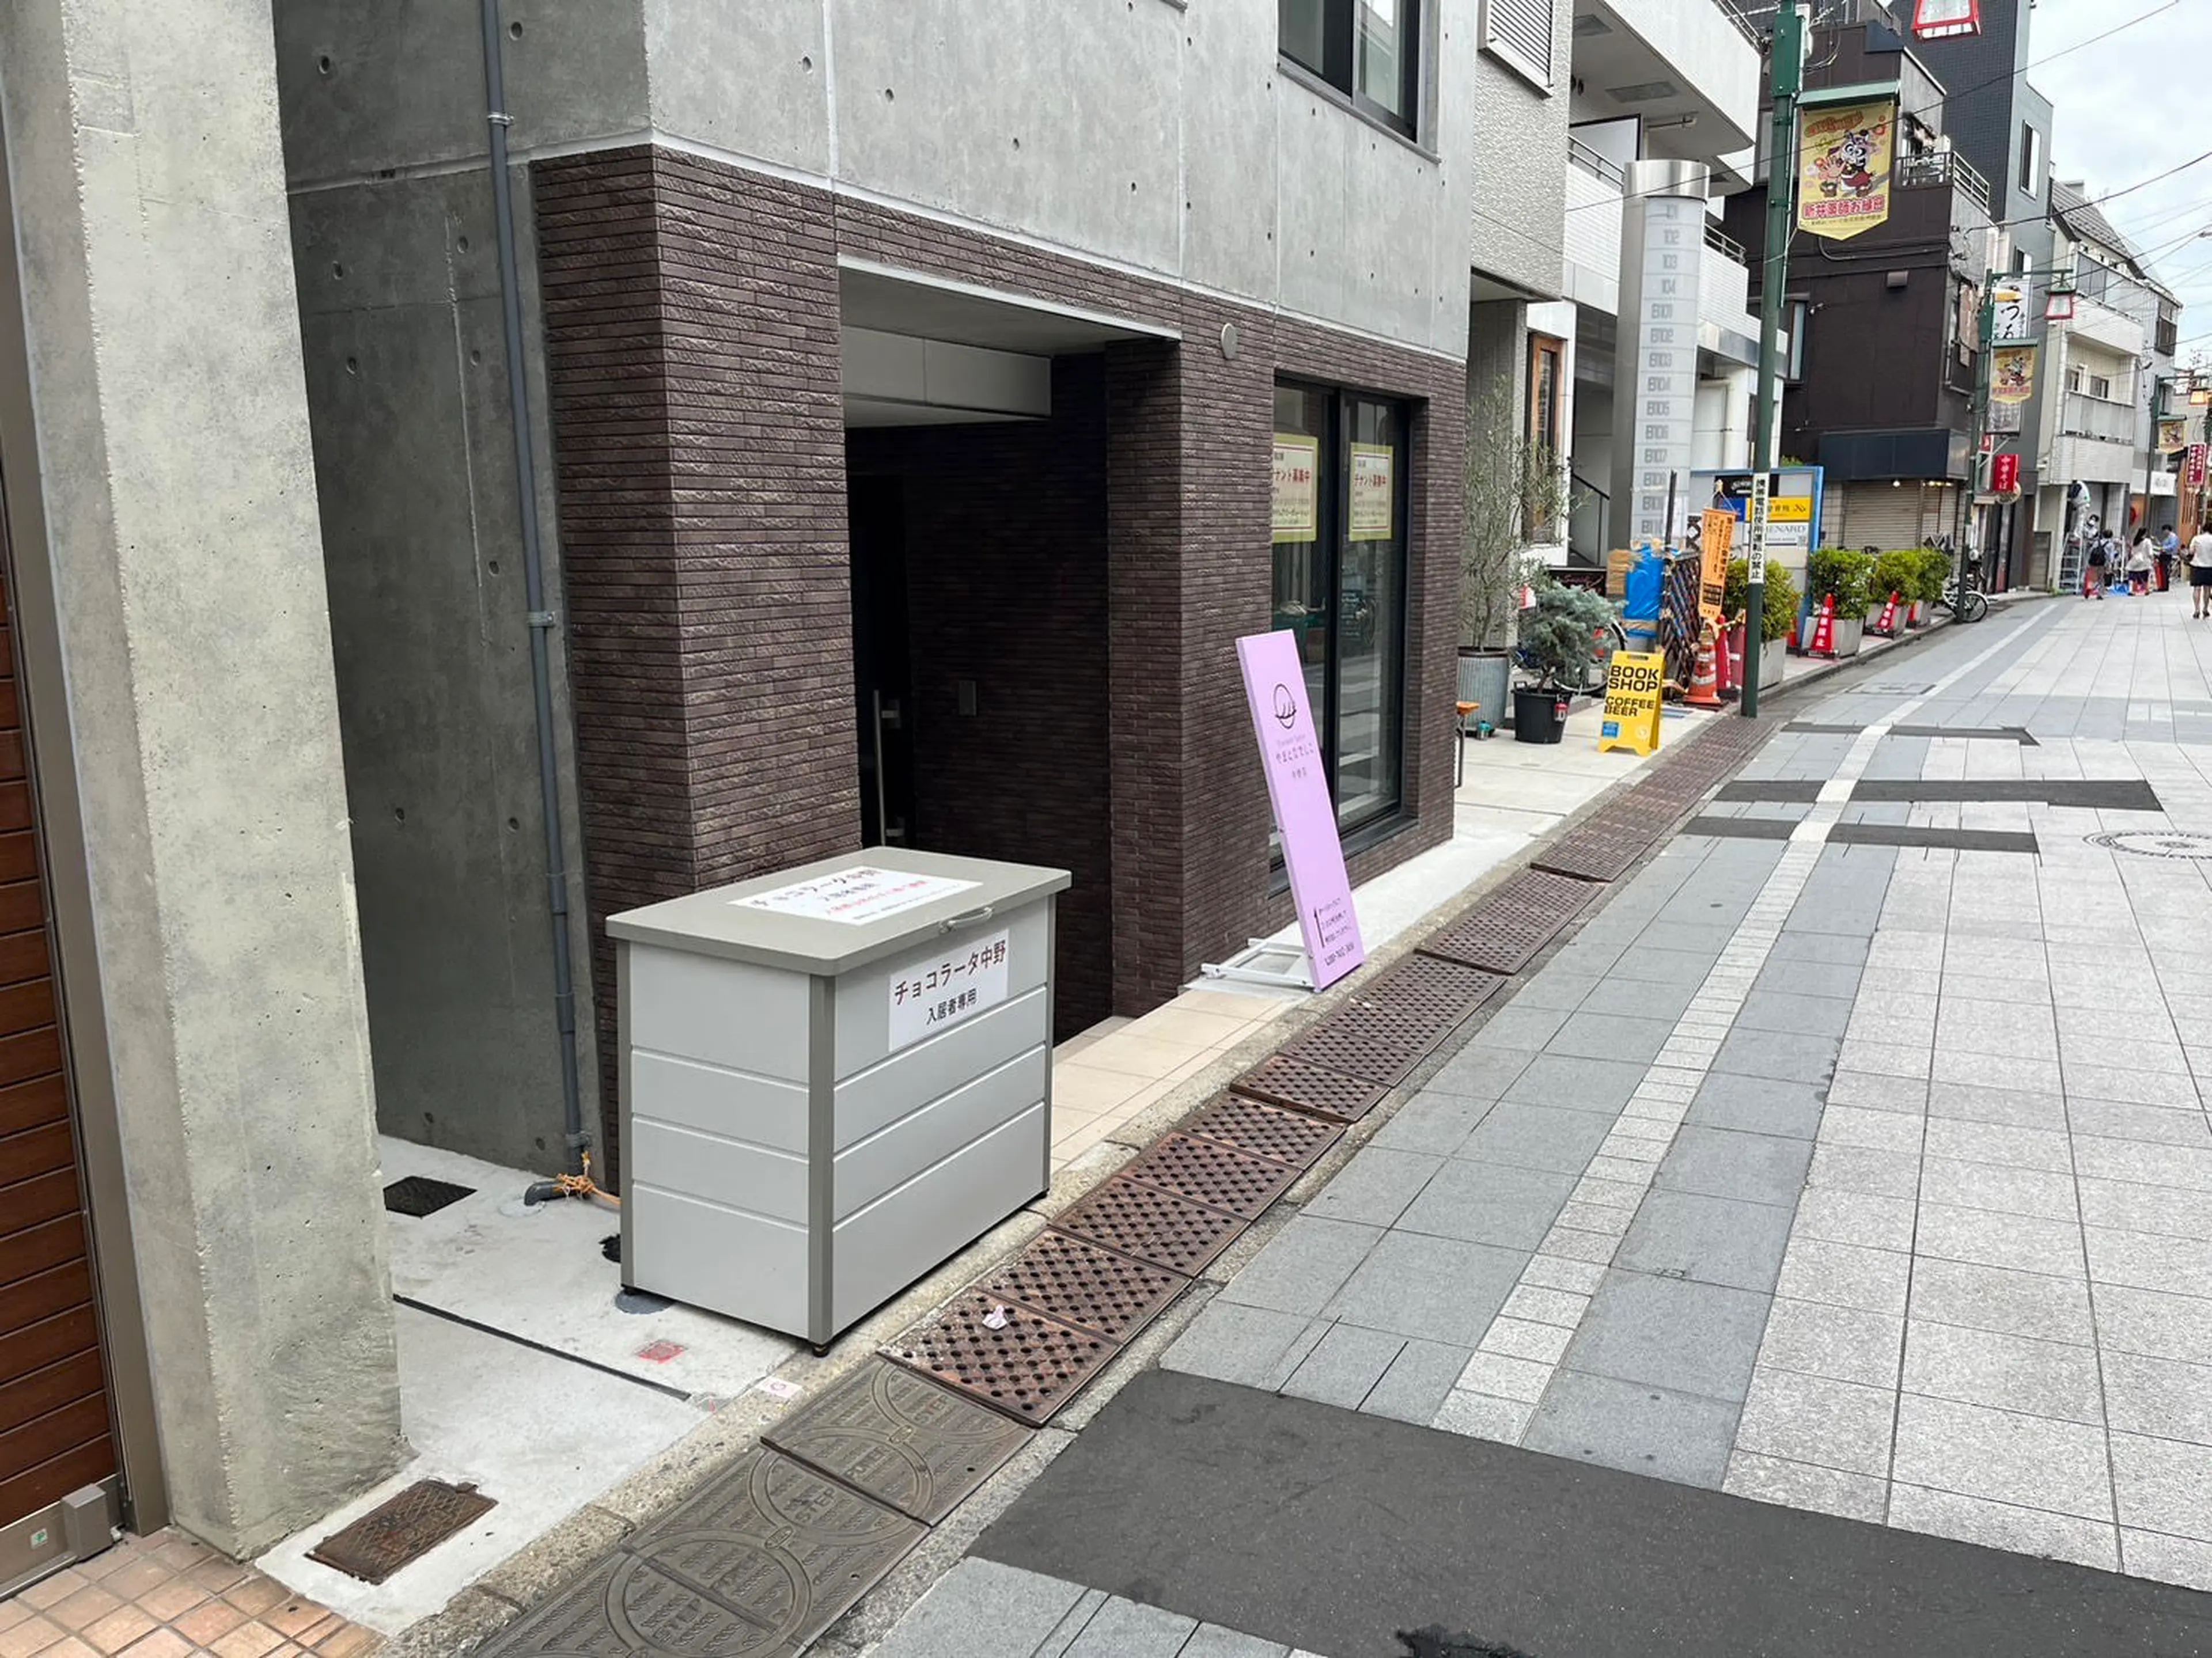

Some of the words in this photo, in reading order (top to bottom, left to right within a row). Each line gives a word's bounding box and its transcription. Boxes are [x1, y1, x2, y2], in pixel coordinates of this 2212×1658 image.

[1649, 352, 1672, 367] B103
[1647, 376, 1670, 391] B104
[1645, 448, 1667, 463] B107
[1611, 665, 1659, 681] BOOK
[1608, 678, 1658, 693] SHOP
[1605, 696, 1656, 710] COFFEE
[1604, 705, 1638, 717] BEER
[894, 939, 1006, 1006] チョコラータ中野
[926, 987, 978, 1025] 入居者専用
[794, 1487, 835, 1522] STEP
